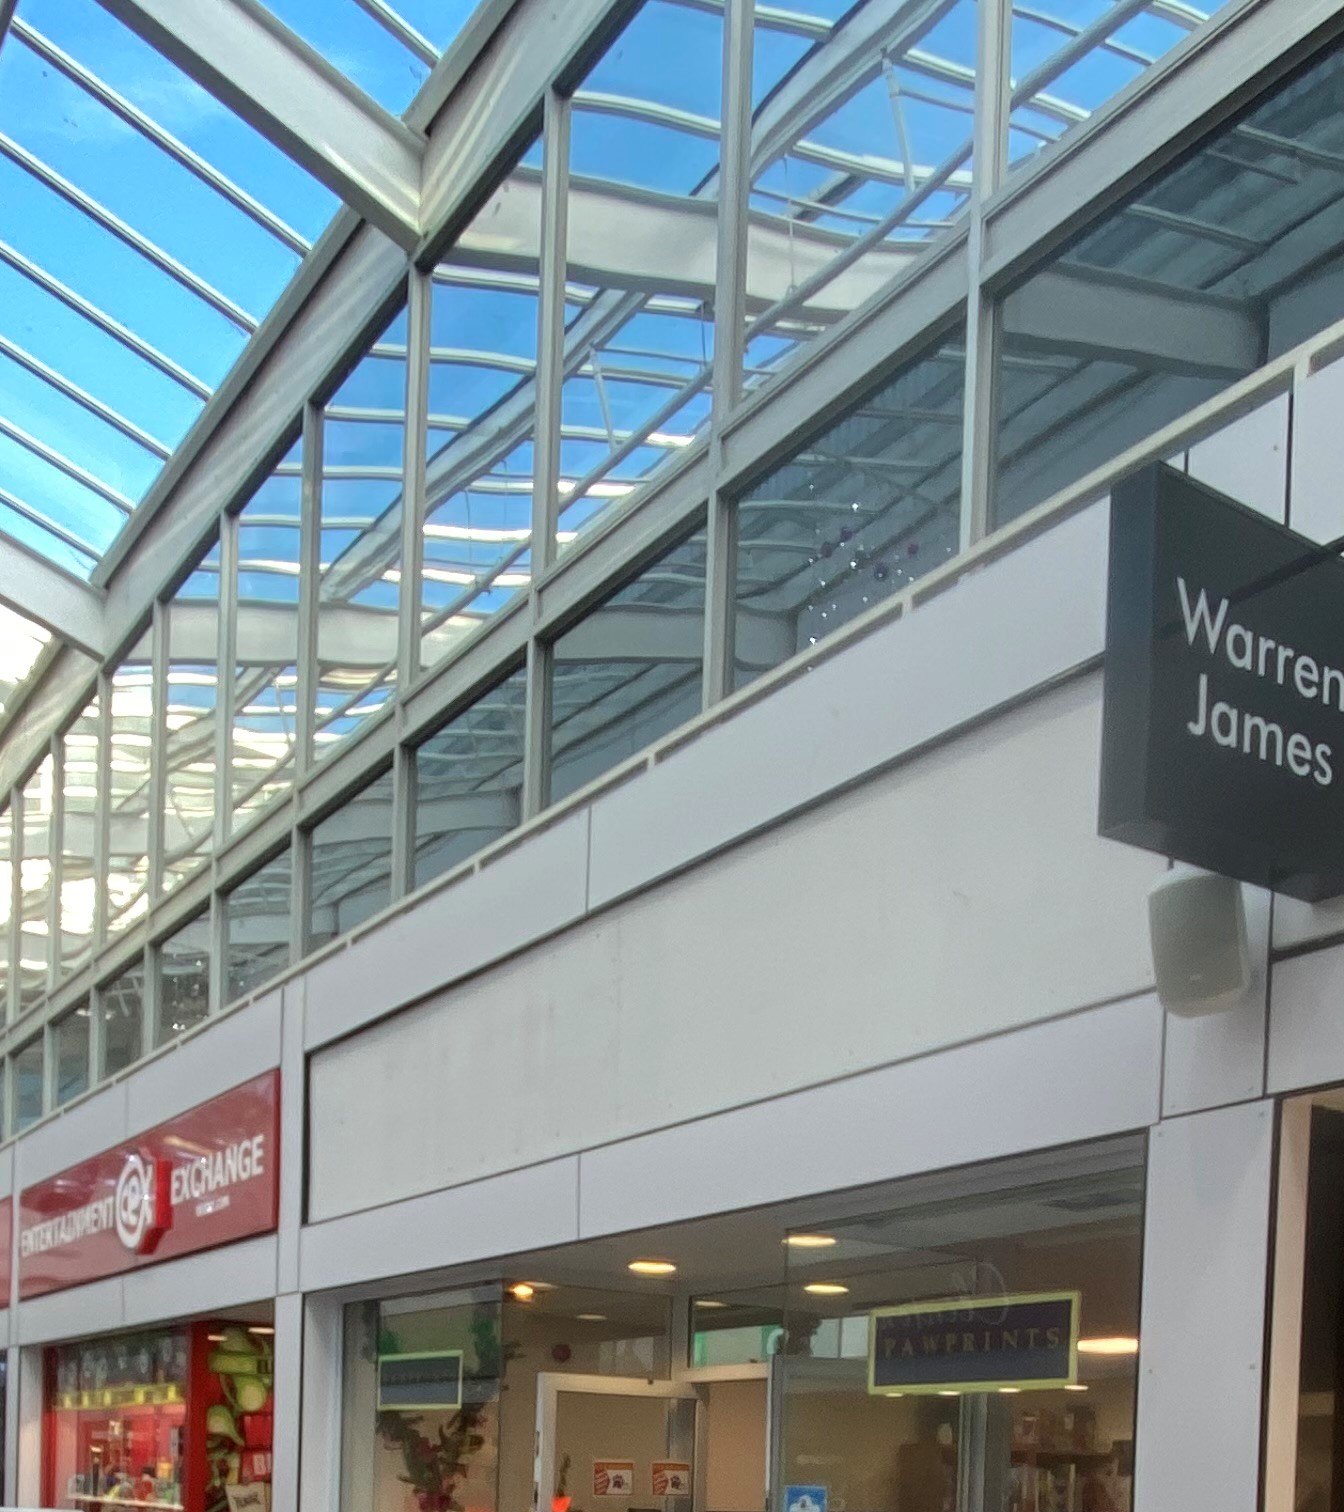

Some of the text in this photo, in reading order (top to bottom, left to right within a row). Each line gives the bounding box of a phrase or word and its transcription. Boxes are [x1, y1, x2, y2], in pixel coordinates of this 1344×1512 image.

[1187, 673, 1333, 786] James
[20, 1196, 115, 1258] ENTERTAINMENT
[170, 1134, 265, 1206] EXCHANGE
